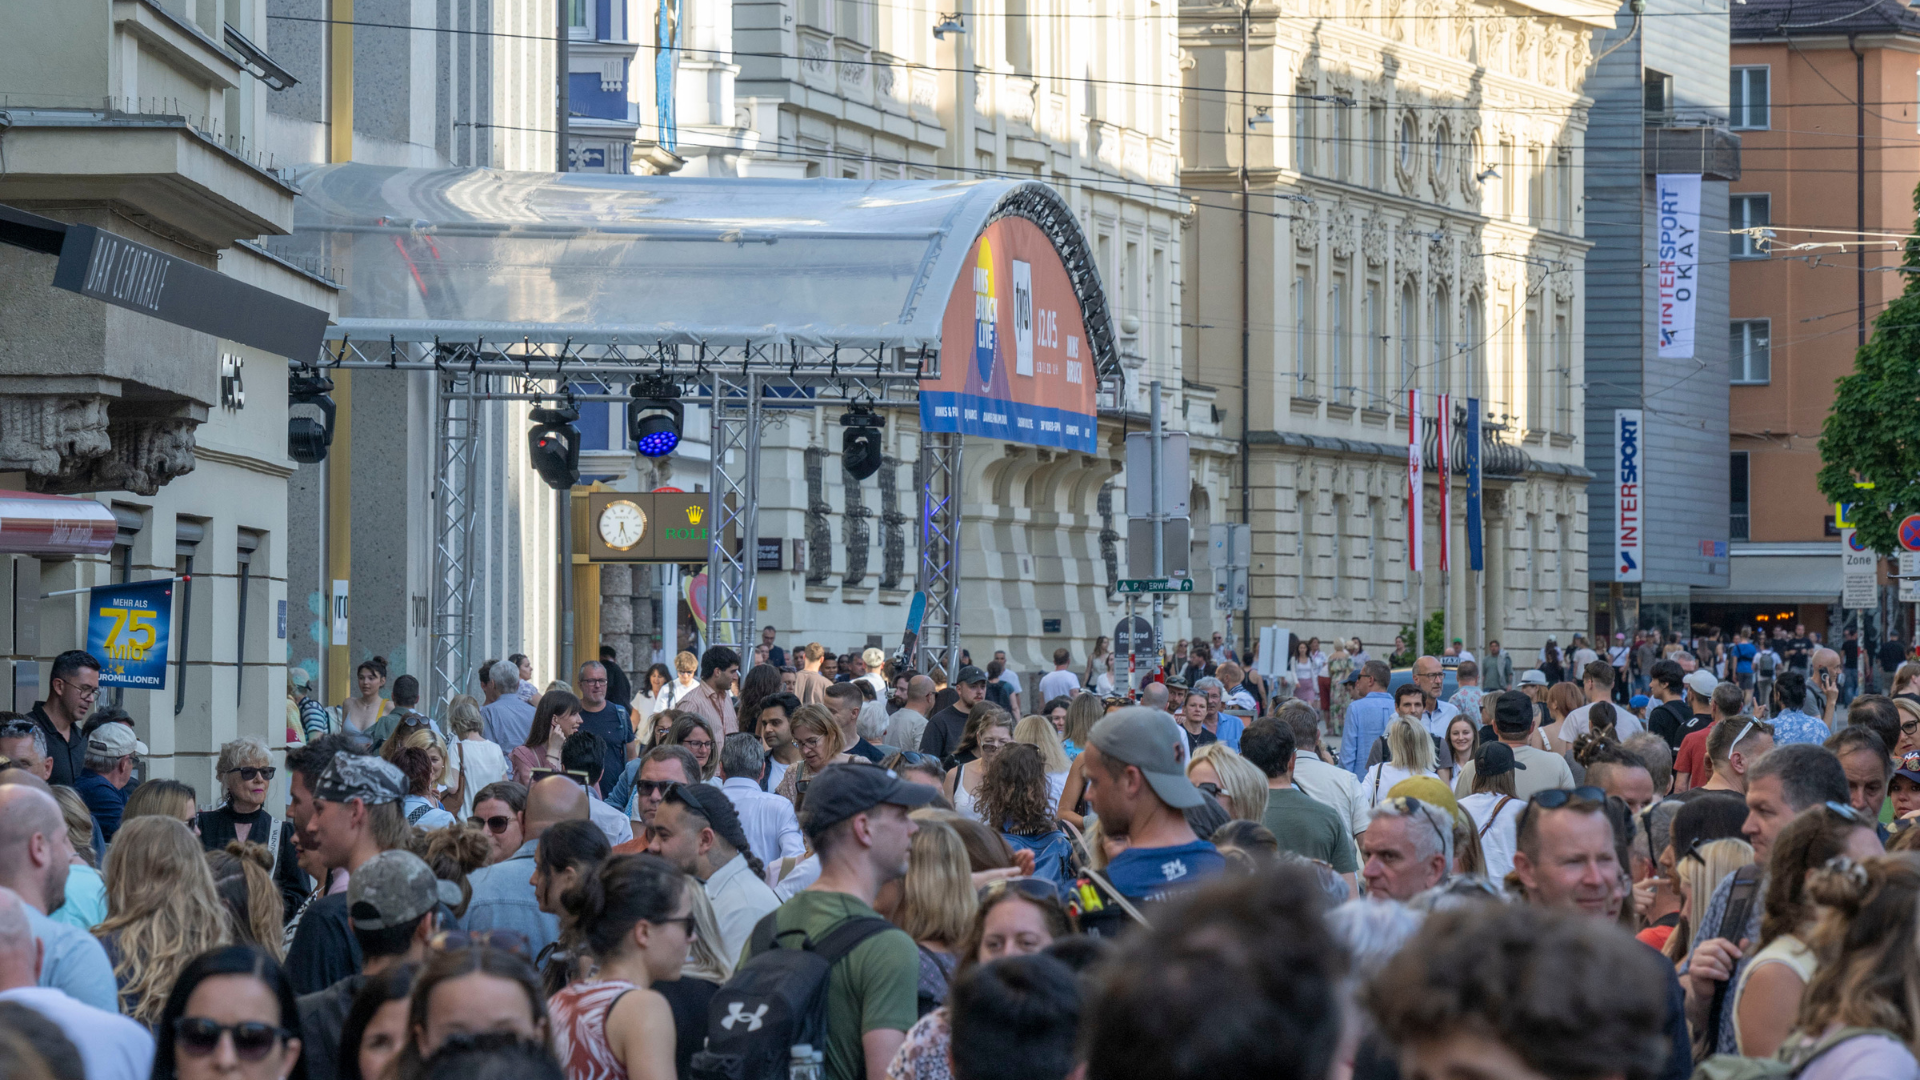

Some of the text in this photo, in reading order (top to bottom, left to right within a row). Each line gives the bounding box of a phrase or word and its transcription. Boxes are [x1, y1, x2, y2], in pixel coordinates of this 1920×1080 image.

[1660, 188, 1678, 325] INTERSPORT
[1676, 224, 1694, 302] OKAY
[87, 236, 170, 311] BAR CENTRALE
[975, 294, 998, 324] BRUCK
[1066, 359, 1083, 385] BRUCK
[1620, 417, 1637, 547] INTERSPORT
[665, 527, 709, 540] ROLE
[1846, 555, 1871, 566] Zone
[112, 598, 148, 608] MEHR ALS
[100, 607, 157, 651] 75
[1119, 631, 1148, 639] Statrad
[109, 644, 147, 661] MIO.
[98, 673, 160, 684] UROMILLIONEN
